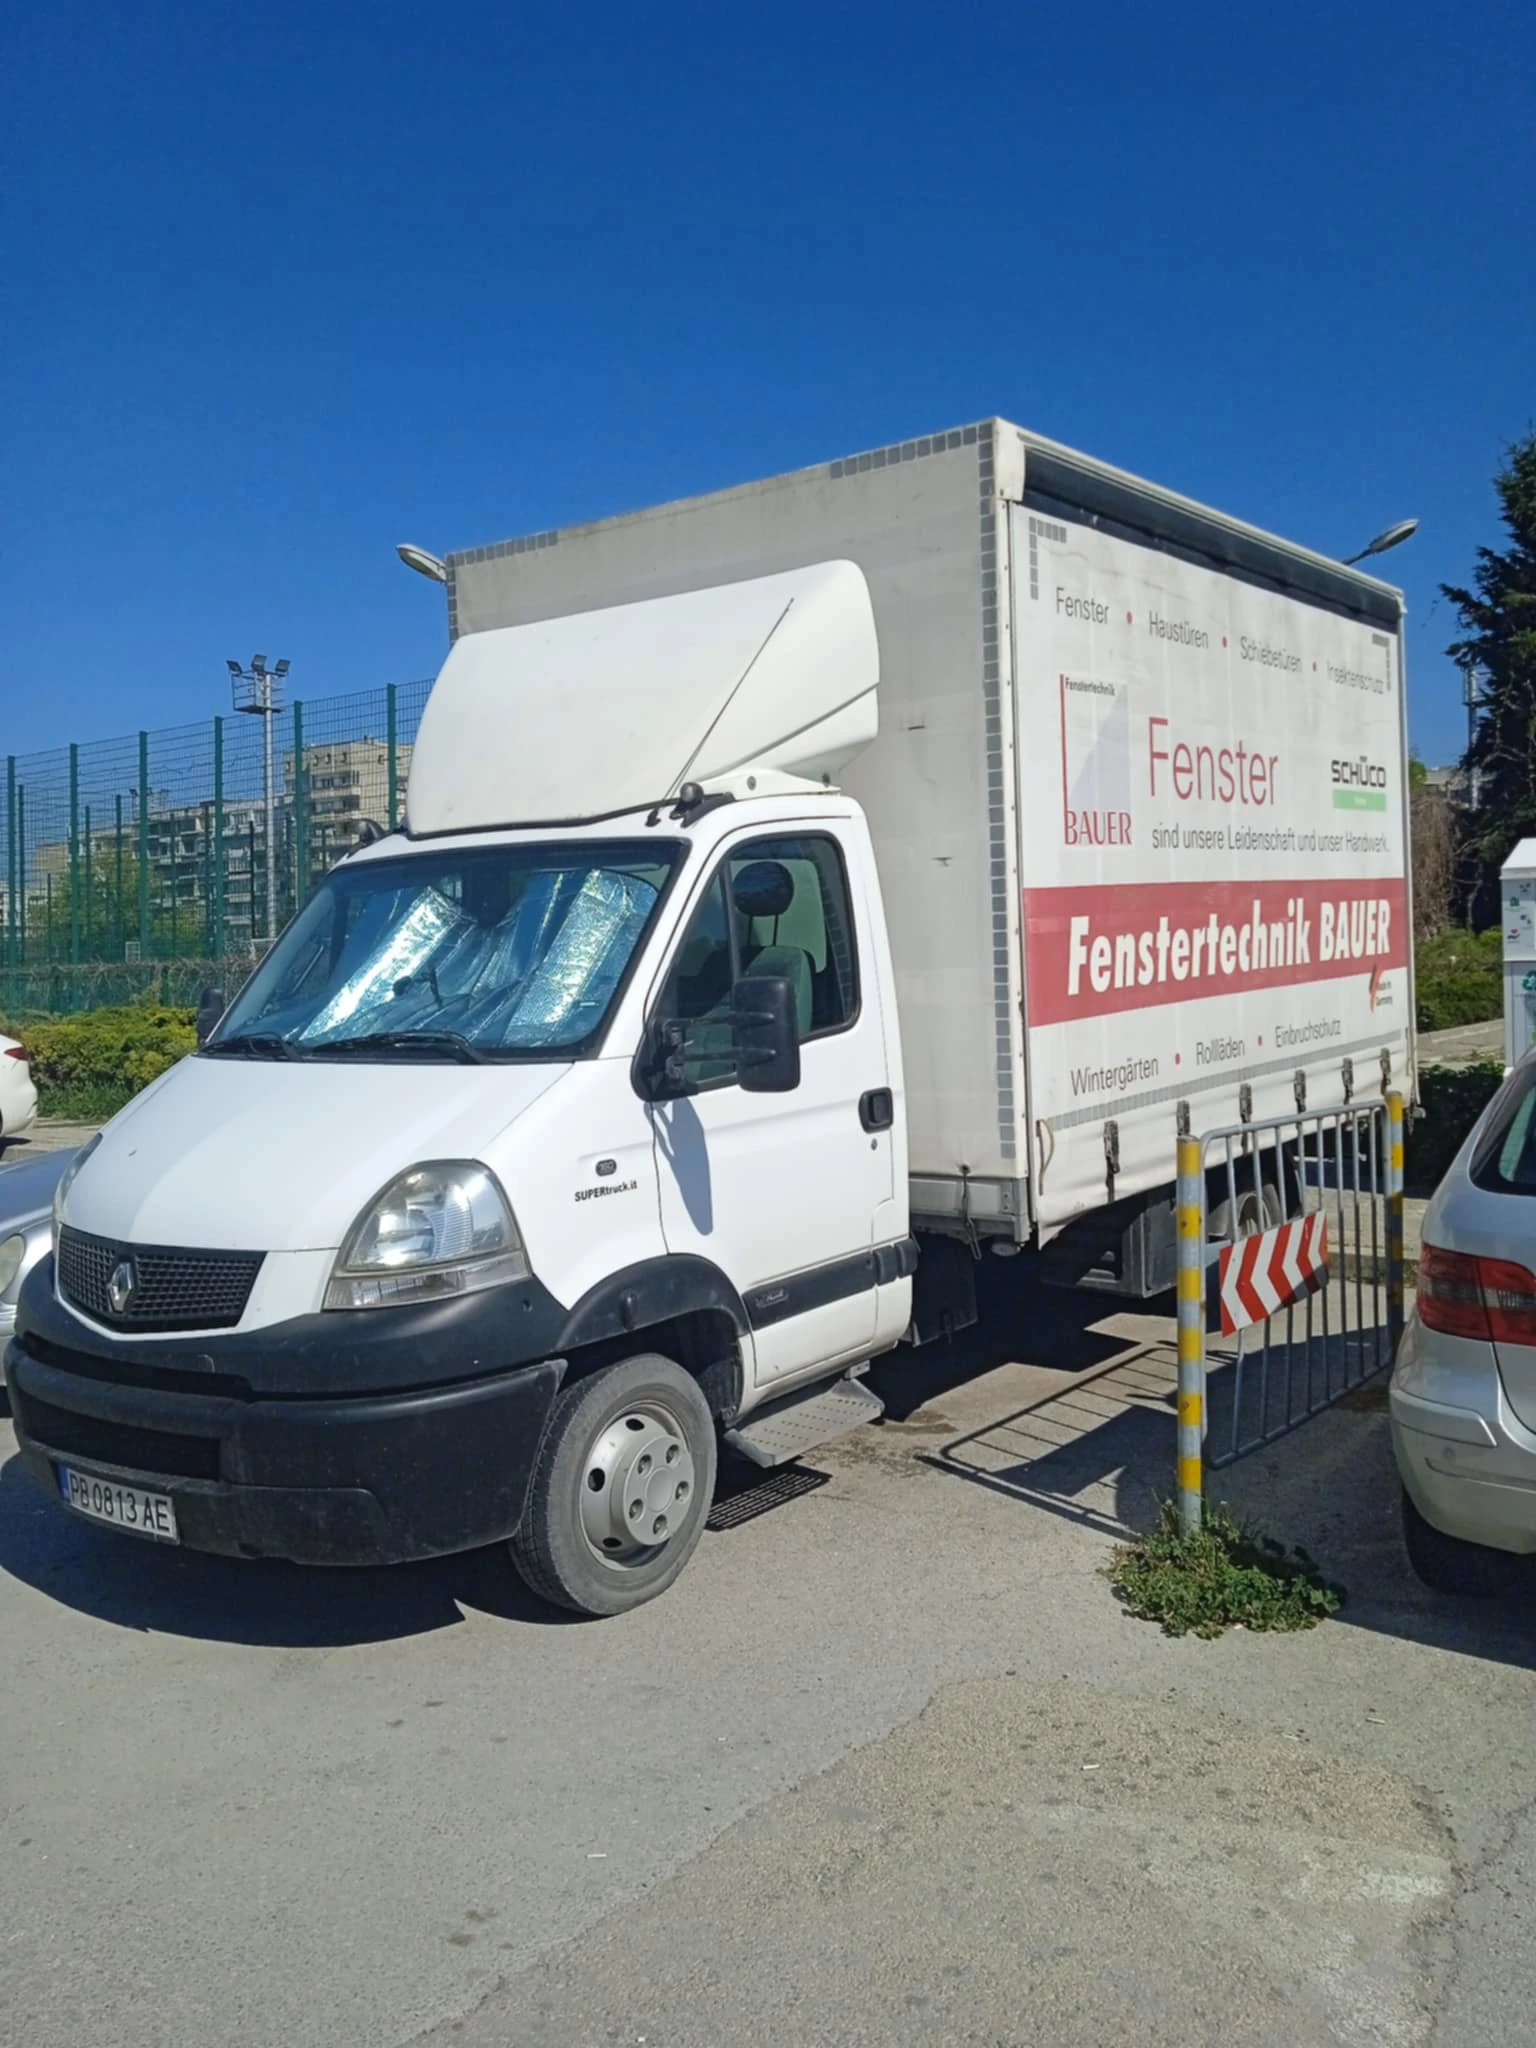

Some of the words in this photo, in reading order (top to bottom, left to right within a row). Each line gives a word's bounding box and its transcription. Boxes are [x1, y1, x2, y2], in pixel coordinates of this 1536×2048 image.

[1056, 586, 1109, 624] Fenster
[1149, 610, 1209, 648] Haustüren
[1149, 716, 1279, 806] Fenster
[1331, 755, 1387, 788] SCHÜCO
[1065, 810, 1132, 845] BAUER
[1152, 822, 1180, 849] sind
[1183, 829, 1225, 851] unsere
[1227, 824, 1296, 852] Leidenschaft
[1298, 828, 1316, 852] und
[1068, 898, 1311, 996] Fenstertechnik
[1319, 900, 1392, 962] BAUER
[1071, 1056, 1160, 1097] Wintergärten
[1275, 1018, 1342, 1049] Einbruchschutz
[574, 1179, 638, 1202] SUPERtruck.it
[69, 1472, 90, 1508] PB
[93, 1482, 138, 1523] 0813
[142, 1495, 171, 1533] AE
